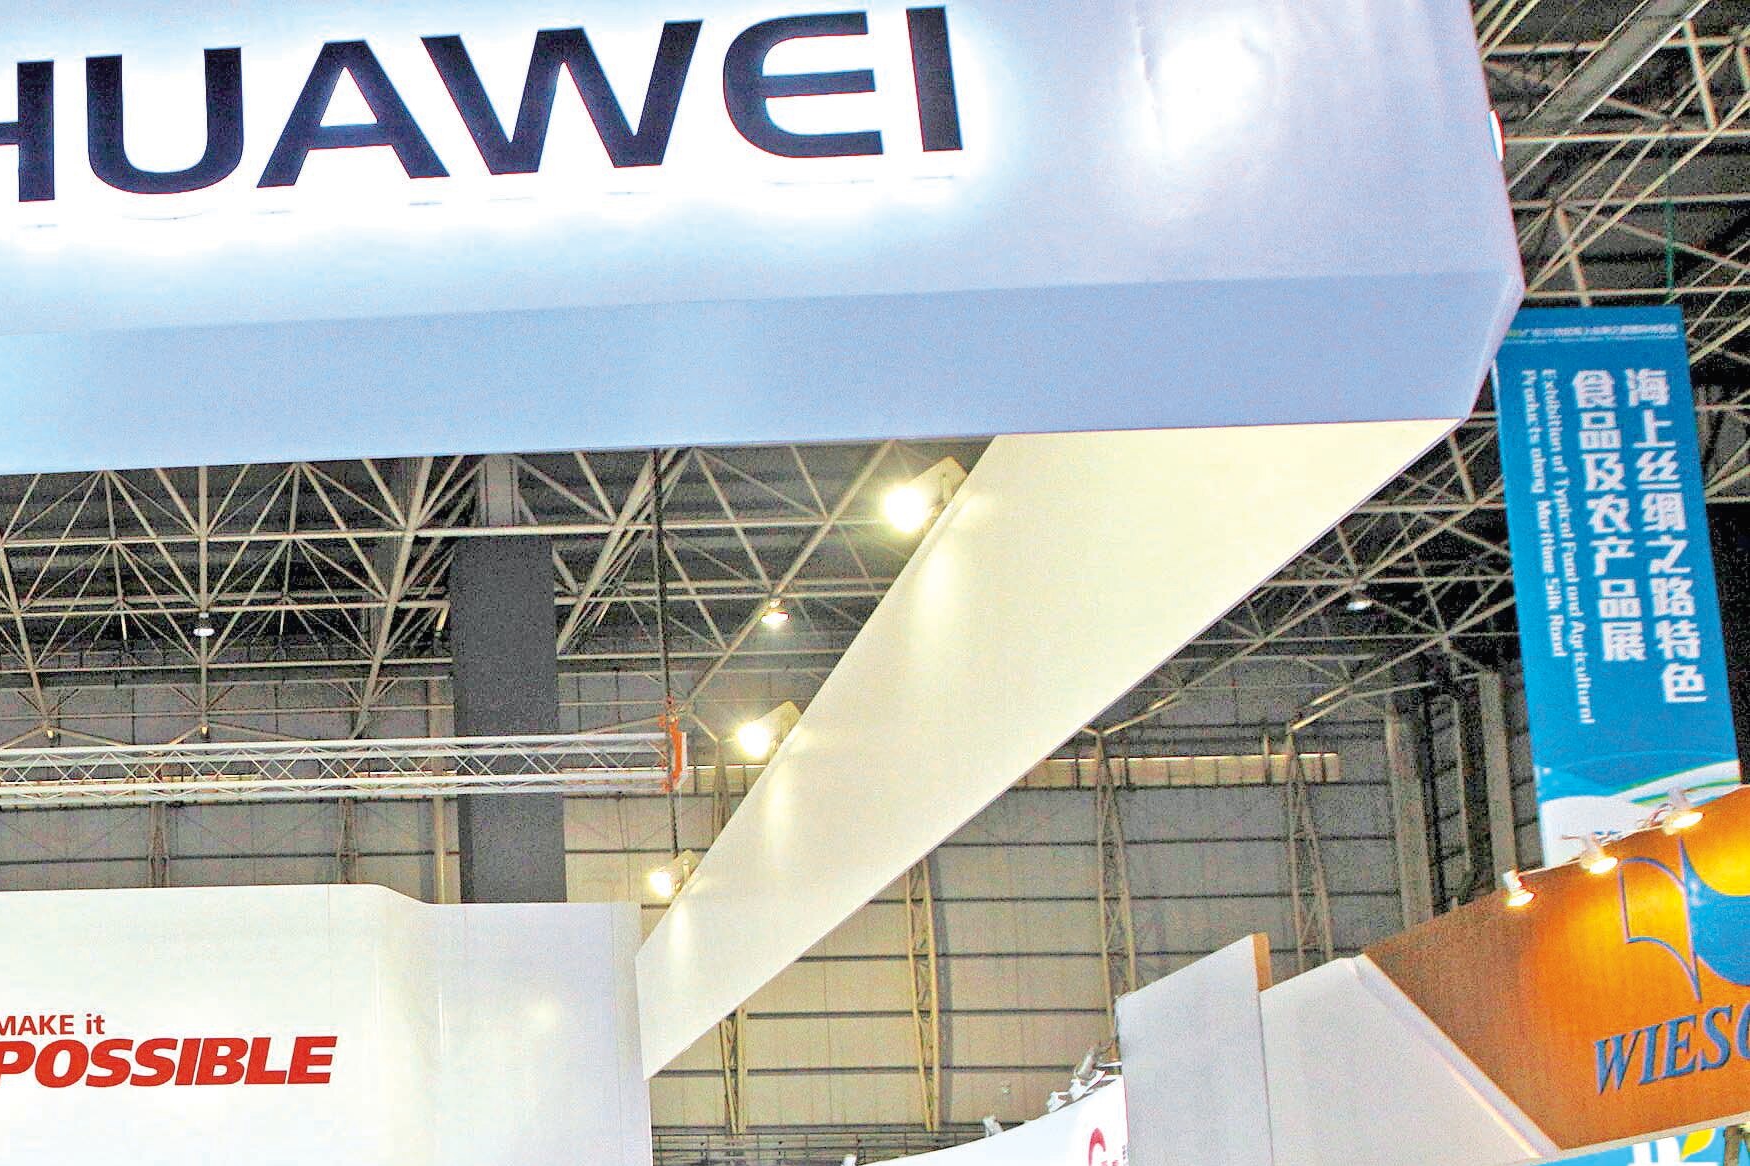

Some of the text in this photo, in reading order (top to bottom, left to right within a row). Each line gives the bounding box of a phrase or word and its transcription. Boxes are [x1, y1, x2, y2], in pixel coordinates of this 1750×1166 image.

[1571, 368, 1647, 662] 食品及农产品展
[1625, 367, 1707, 704] 海上丝绸之路特色
[86, 1012, 106, 1035] it
